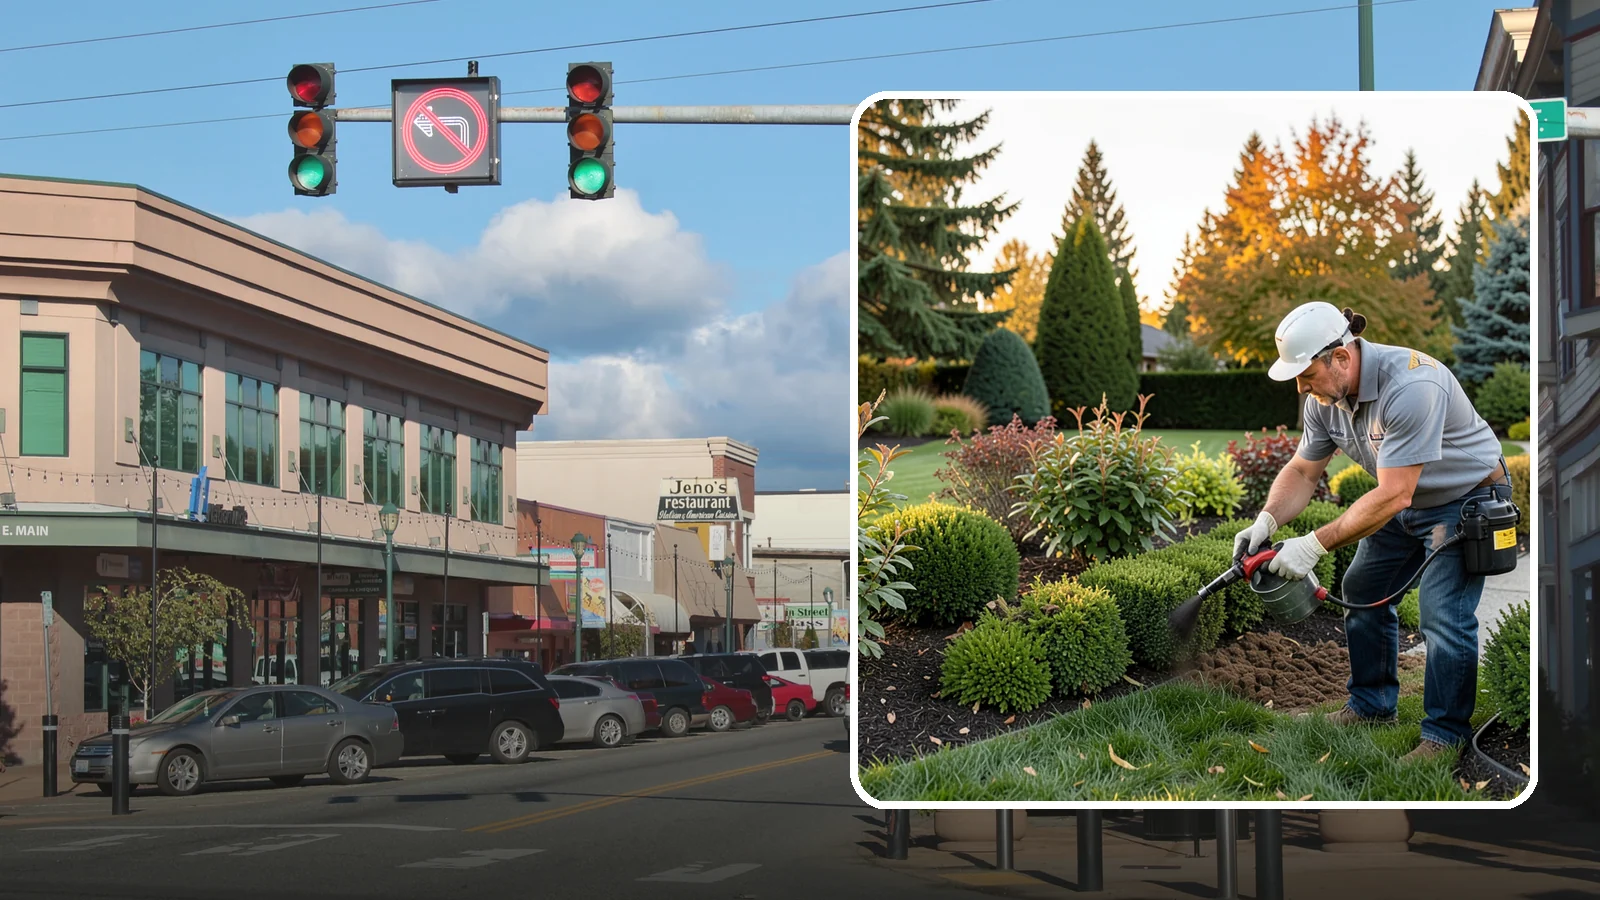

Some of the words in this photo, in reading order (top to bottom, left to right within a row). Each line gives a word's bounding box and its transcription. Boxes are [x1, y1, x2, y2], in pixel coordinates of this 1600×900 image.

[669, 480, 727, 494] Jeno's
[665, 497, 731, 508] restaurant
[658, 510, 681, 520] Italian
[686, 510, 714, 519] American
[714, 510, 738, 519] Cuisine
[2, 525, 13, 536] E.
[16, 525, 49, 536] MAIN
[797, 608, 828, 616] Street
[791, 619, 823, 627] lass
